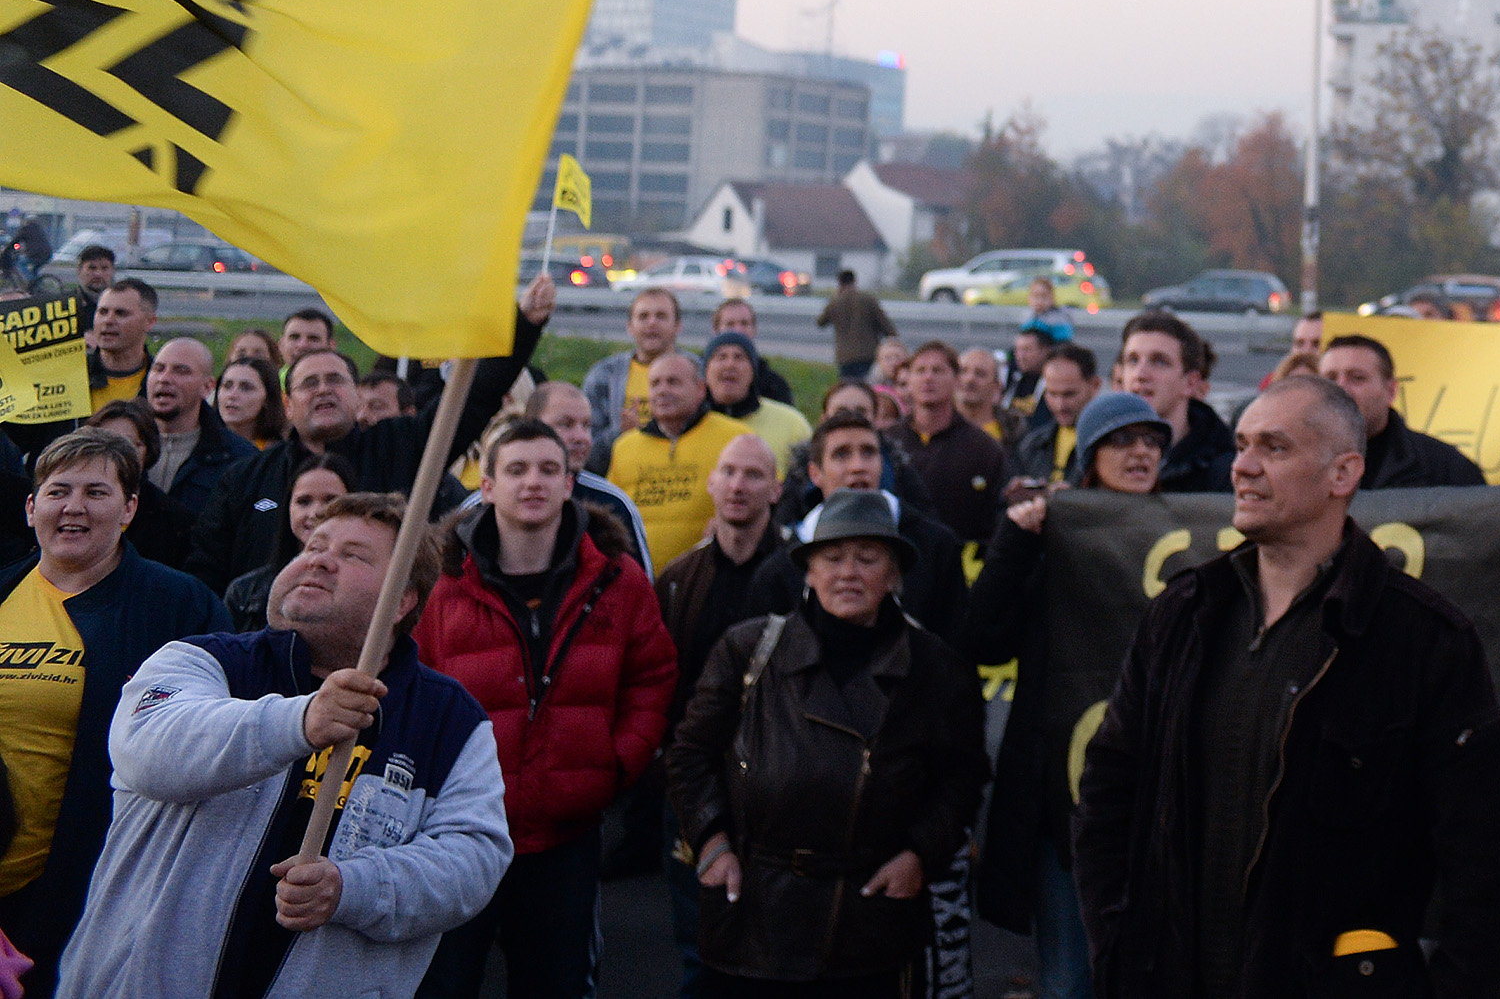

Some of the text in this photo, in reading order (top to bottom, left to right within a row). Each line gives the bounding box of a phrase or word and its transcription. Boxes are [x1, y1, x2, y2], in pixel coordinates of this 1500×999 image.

[46, 297, 77, 321] ILI
[42, 384, 66, 397] ZID
[45, 648, 83, 666] ZI
